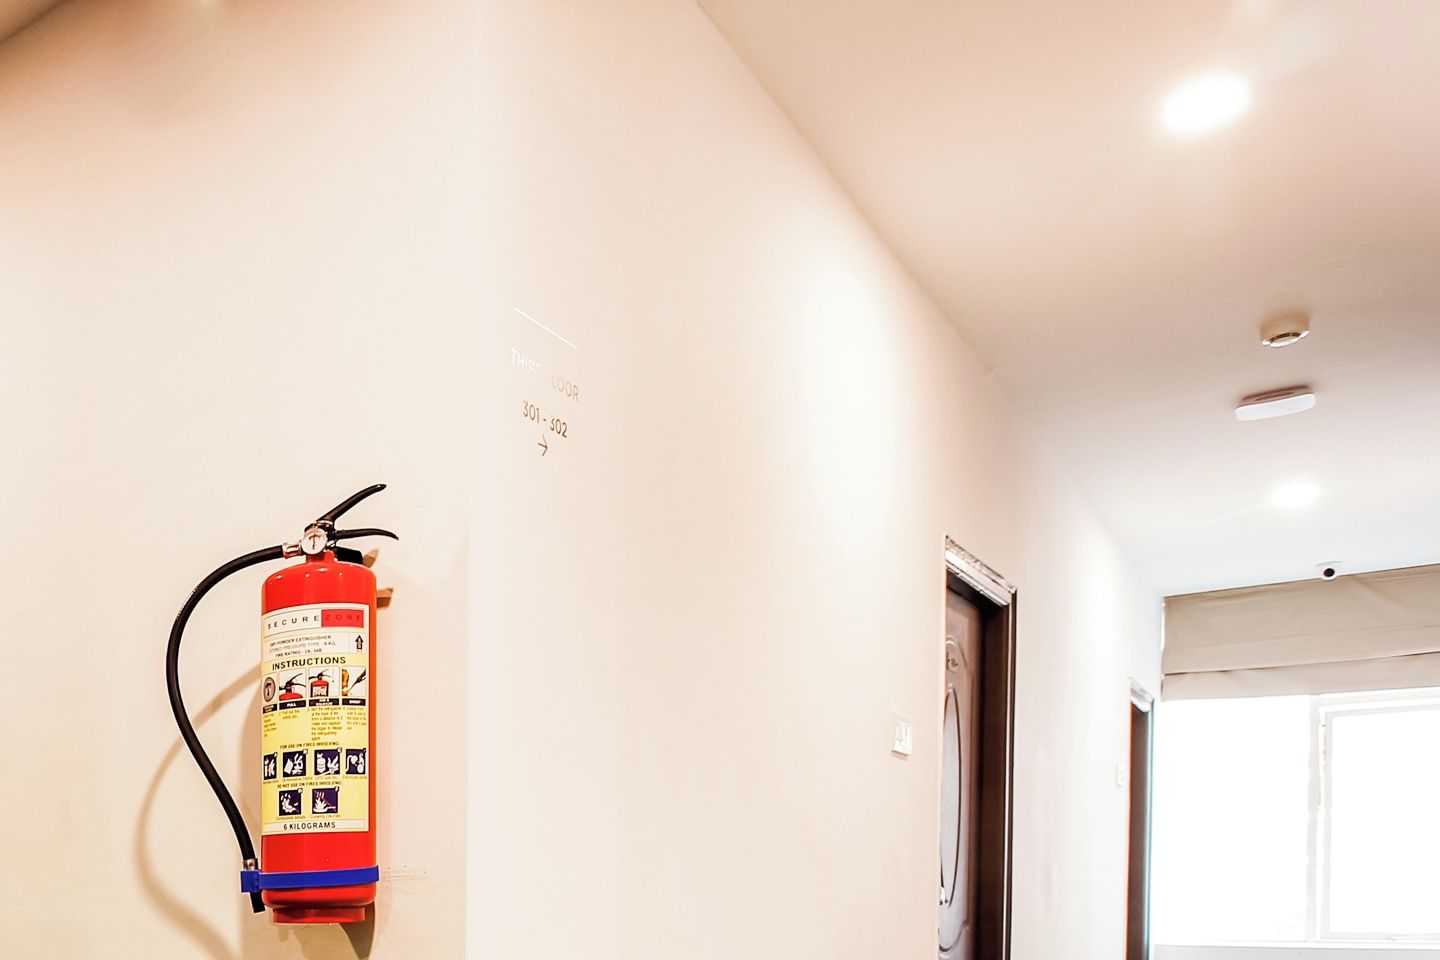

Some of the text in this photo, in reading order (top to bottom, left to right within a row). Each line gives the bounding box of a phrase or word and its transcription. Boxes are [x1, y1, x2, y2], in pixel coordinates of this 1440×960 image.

[523, 400, 540, 423] 301
[550, 415, 568, 438] 302
[267, 614, 320, 629] SECURE
[272, 656, 346, 671] INSTRUCTIONS
[283, 821, 336, 831] 6 KILOGRAMS
